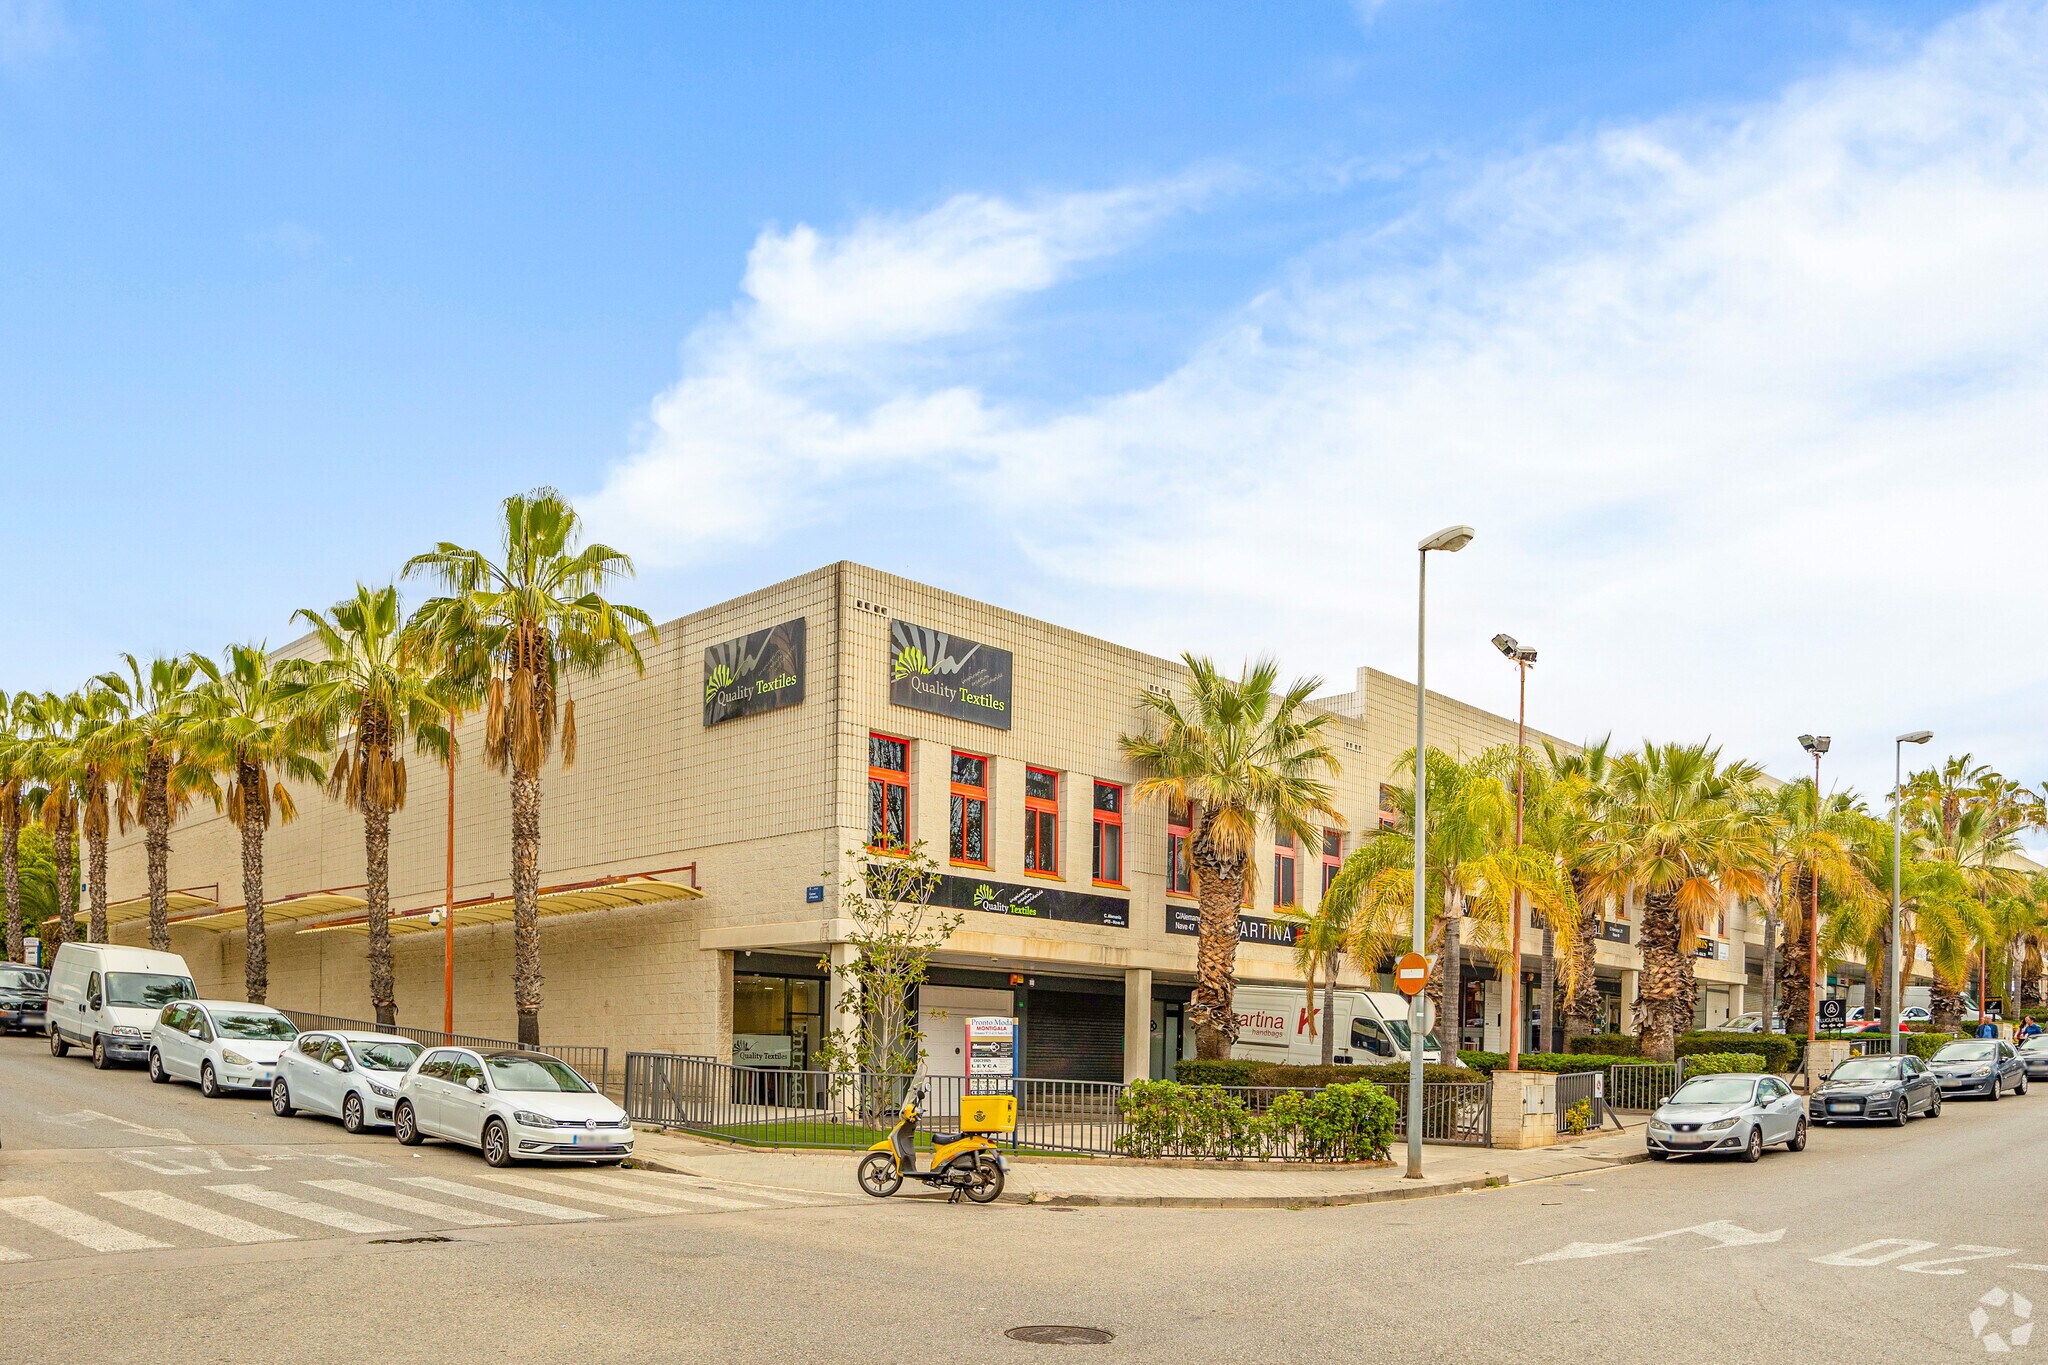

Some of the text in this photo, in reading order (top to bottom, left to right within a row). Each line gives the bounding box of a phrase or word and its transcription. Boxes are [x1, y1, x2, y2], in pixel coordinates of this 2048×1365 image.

[717, 672, 797, 707] Quality Textiles
[911, 675, 1005, 711] Quality Textiles
[982, 900, 1036, 915] Quality Textiles
[1235, 921, 1292, 941] ARTINA
[1252, 1029, 1283, 1039] handbags
[739, 1051, 788, 1061] Quality Textiles
